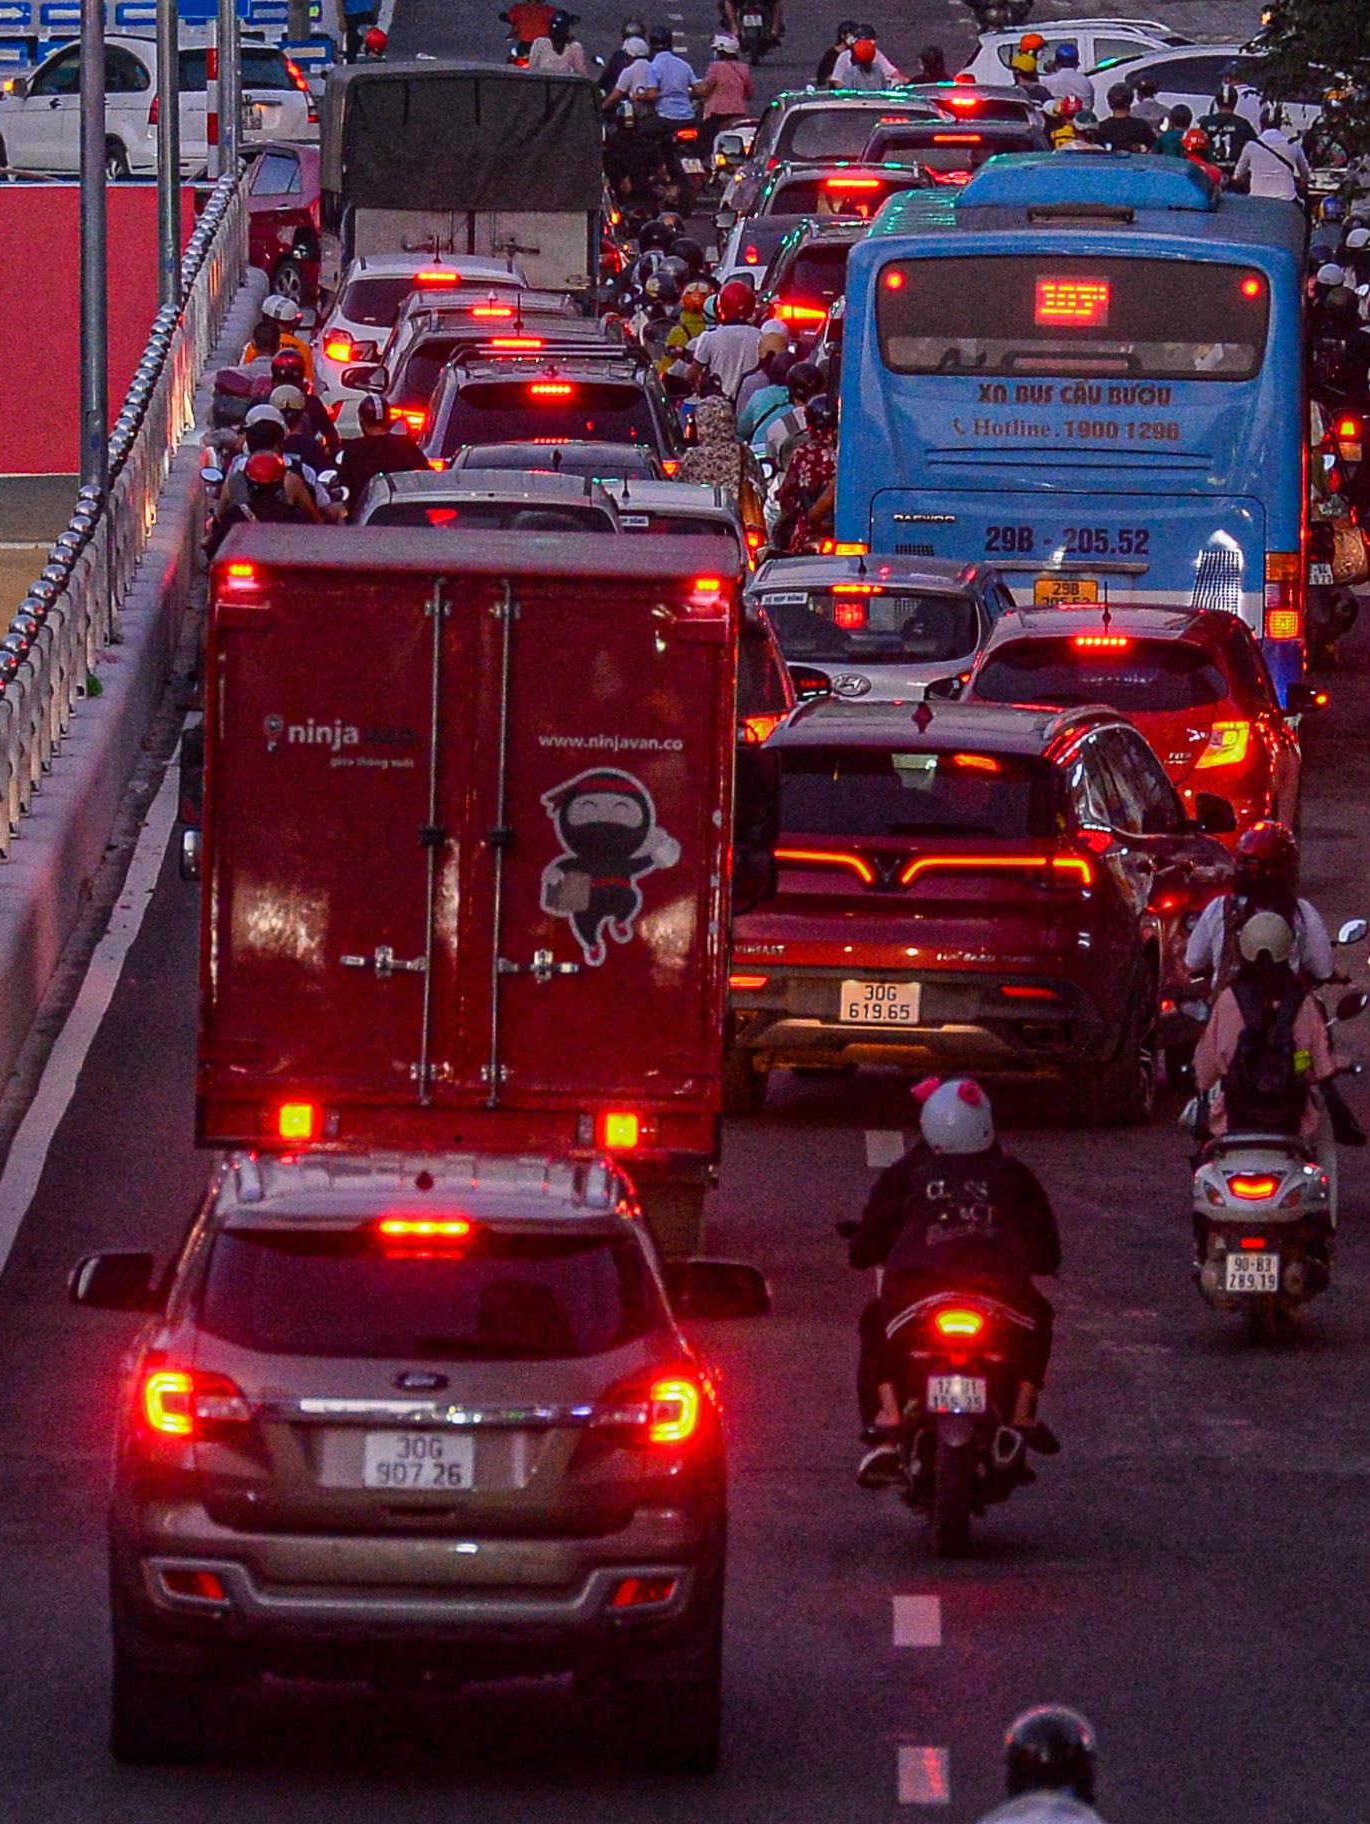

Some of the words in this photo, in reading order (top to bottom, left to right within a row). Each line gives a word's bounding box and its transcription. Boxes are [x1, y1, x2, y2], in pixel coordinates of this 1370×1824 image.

[1014, 384, 1054, 405] BUS
[1064, 420, 1119, 439] 1900
[985, 526, 1034, 551] 29B
[1062, 528, 1150, 555] 205.52
[1051, 582, 1079, 595] 29B
[288, 717, 359, 751] ninja
[538, 734, 684, 752] www.ninjavan.co
[864, 984, 897, 1001] 30G
[849, 1002, 910, 1020] 619.65
[397, 1436, 443, 1459] 30G
